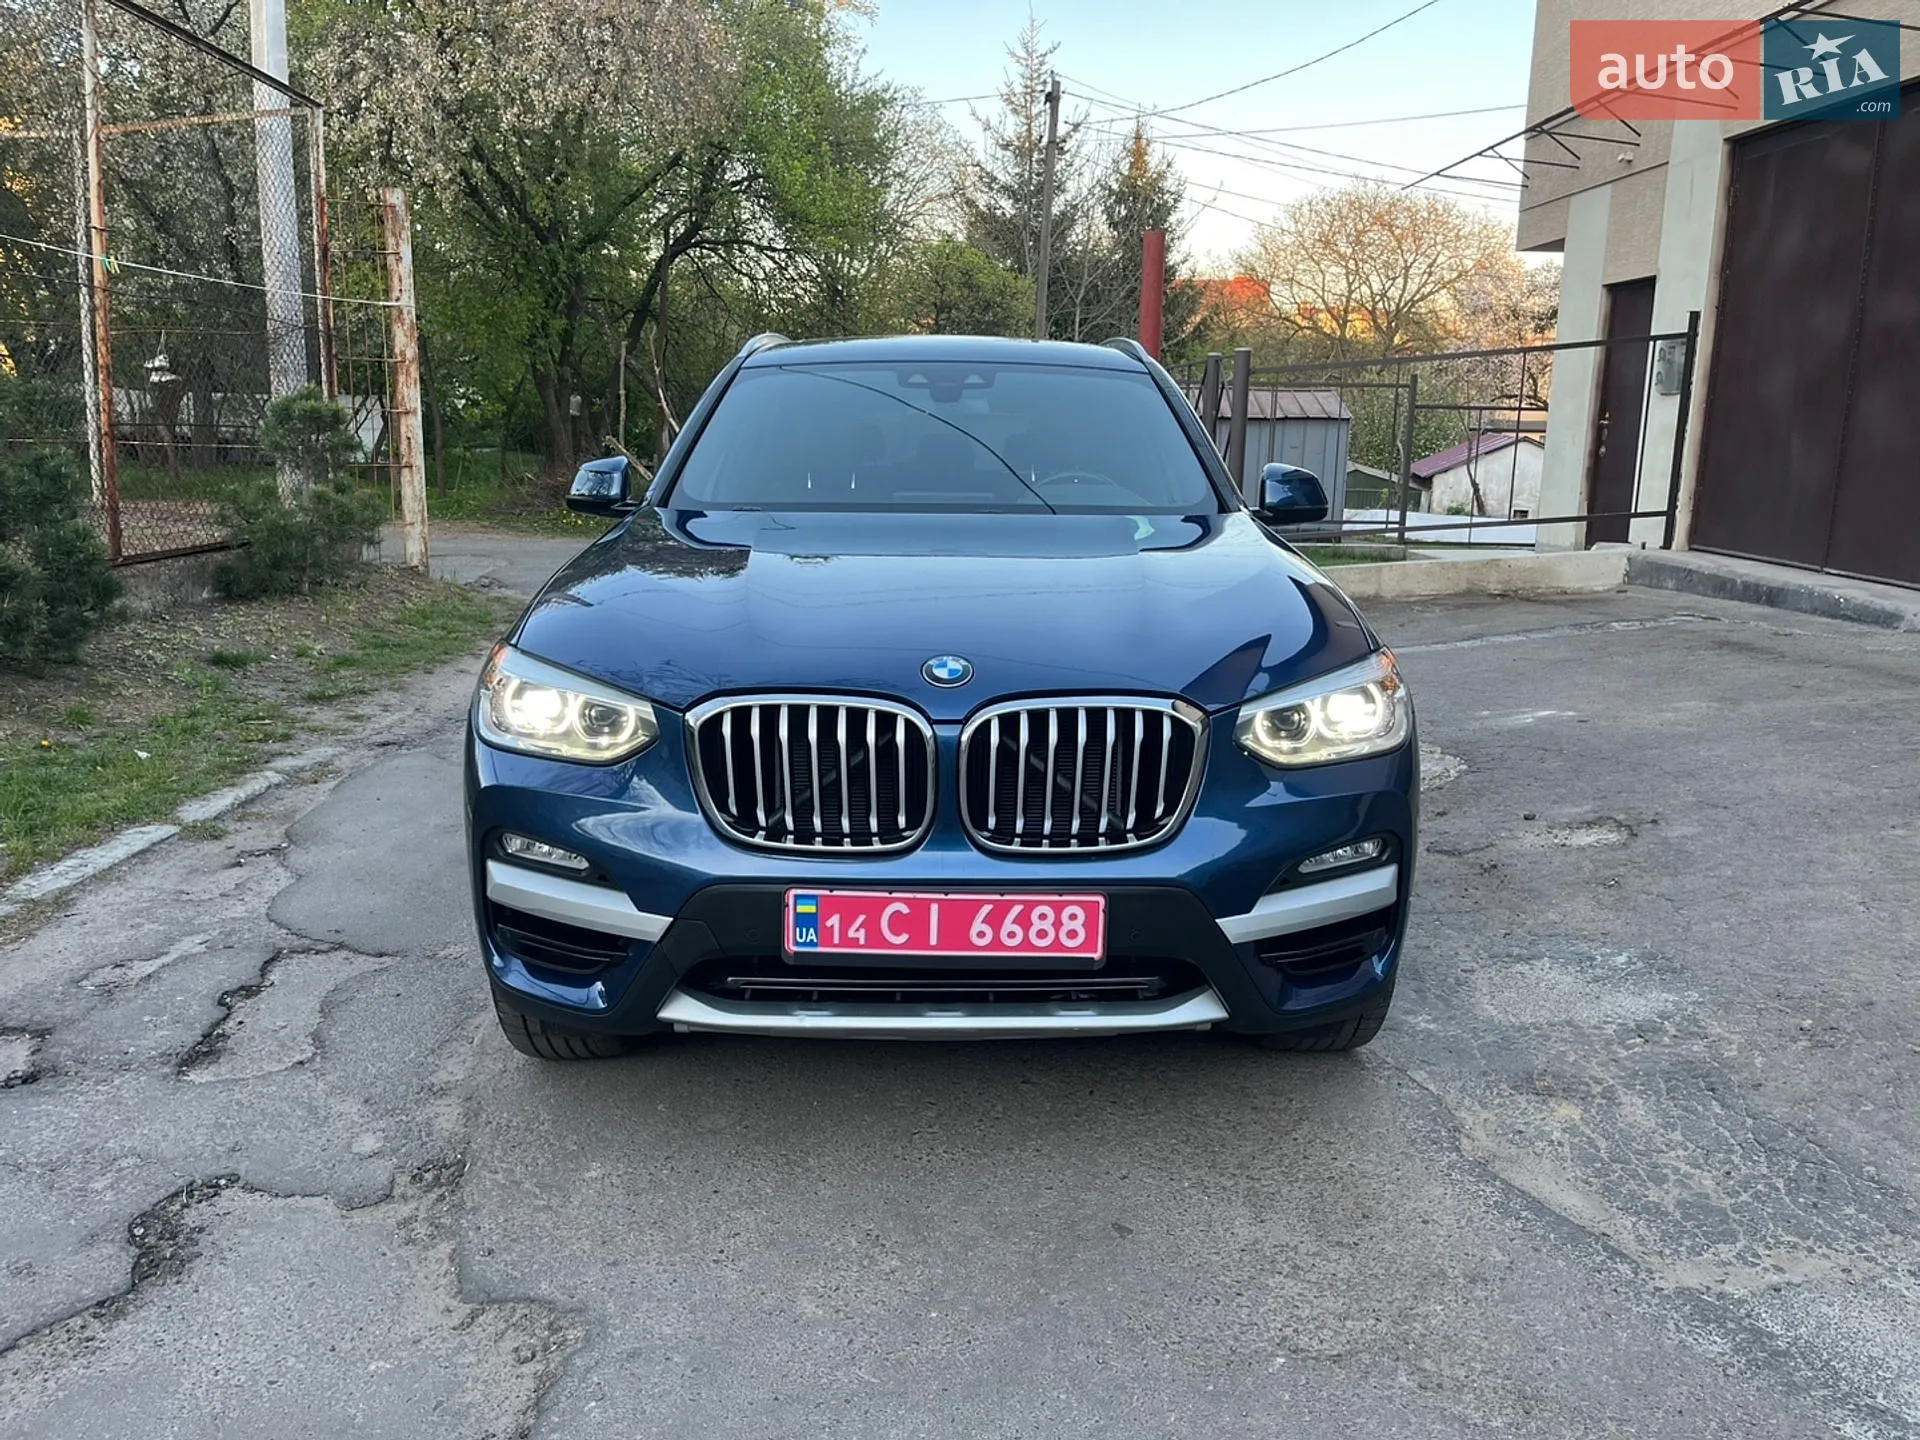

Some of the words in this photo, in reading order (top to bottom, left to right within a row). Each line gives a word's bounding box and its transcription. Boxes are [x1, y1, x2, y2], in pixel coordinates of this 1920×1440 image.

[796, 927, 817, 943] UA
[825, 913, 867, 945] 14
[969, 904, 1086, 948] 6688
